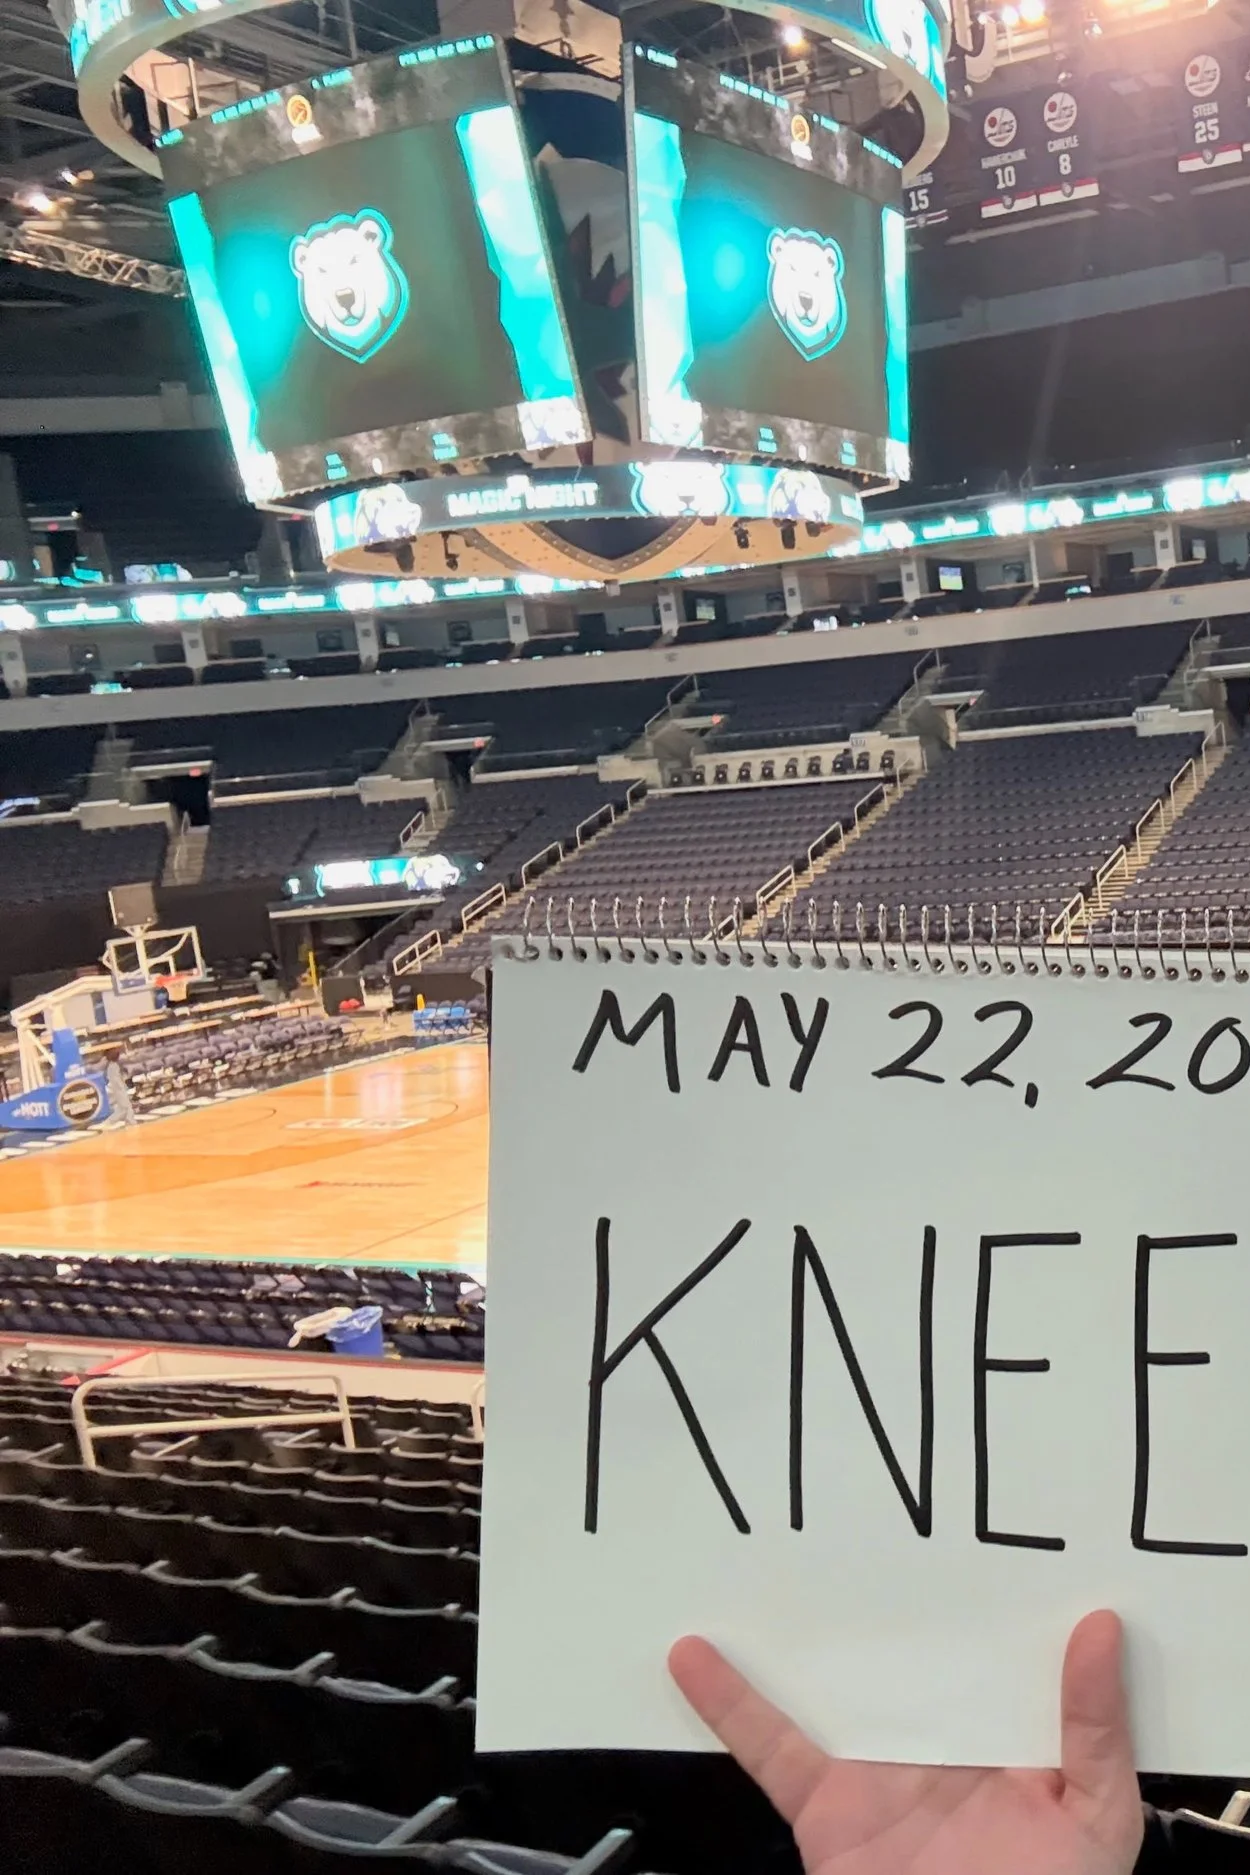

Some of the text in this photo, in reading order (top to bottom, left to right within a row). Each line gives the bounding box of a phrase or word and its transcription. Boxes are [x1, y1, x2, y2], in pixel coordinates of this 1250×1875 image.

[1194, 118, 1220, 144] 25
[1059, 153, 1072, 175] 8
[995, 165, 1017, 190] 10
[909, 188, 929, 212] 15
[525, 482, 599, 510] NIGHT
[573, 989, 830, 1094] MAY
[872, 1000, 1039, 1109] 22,
